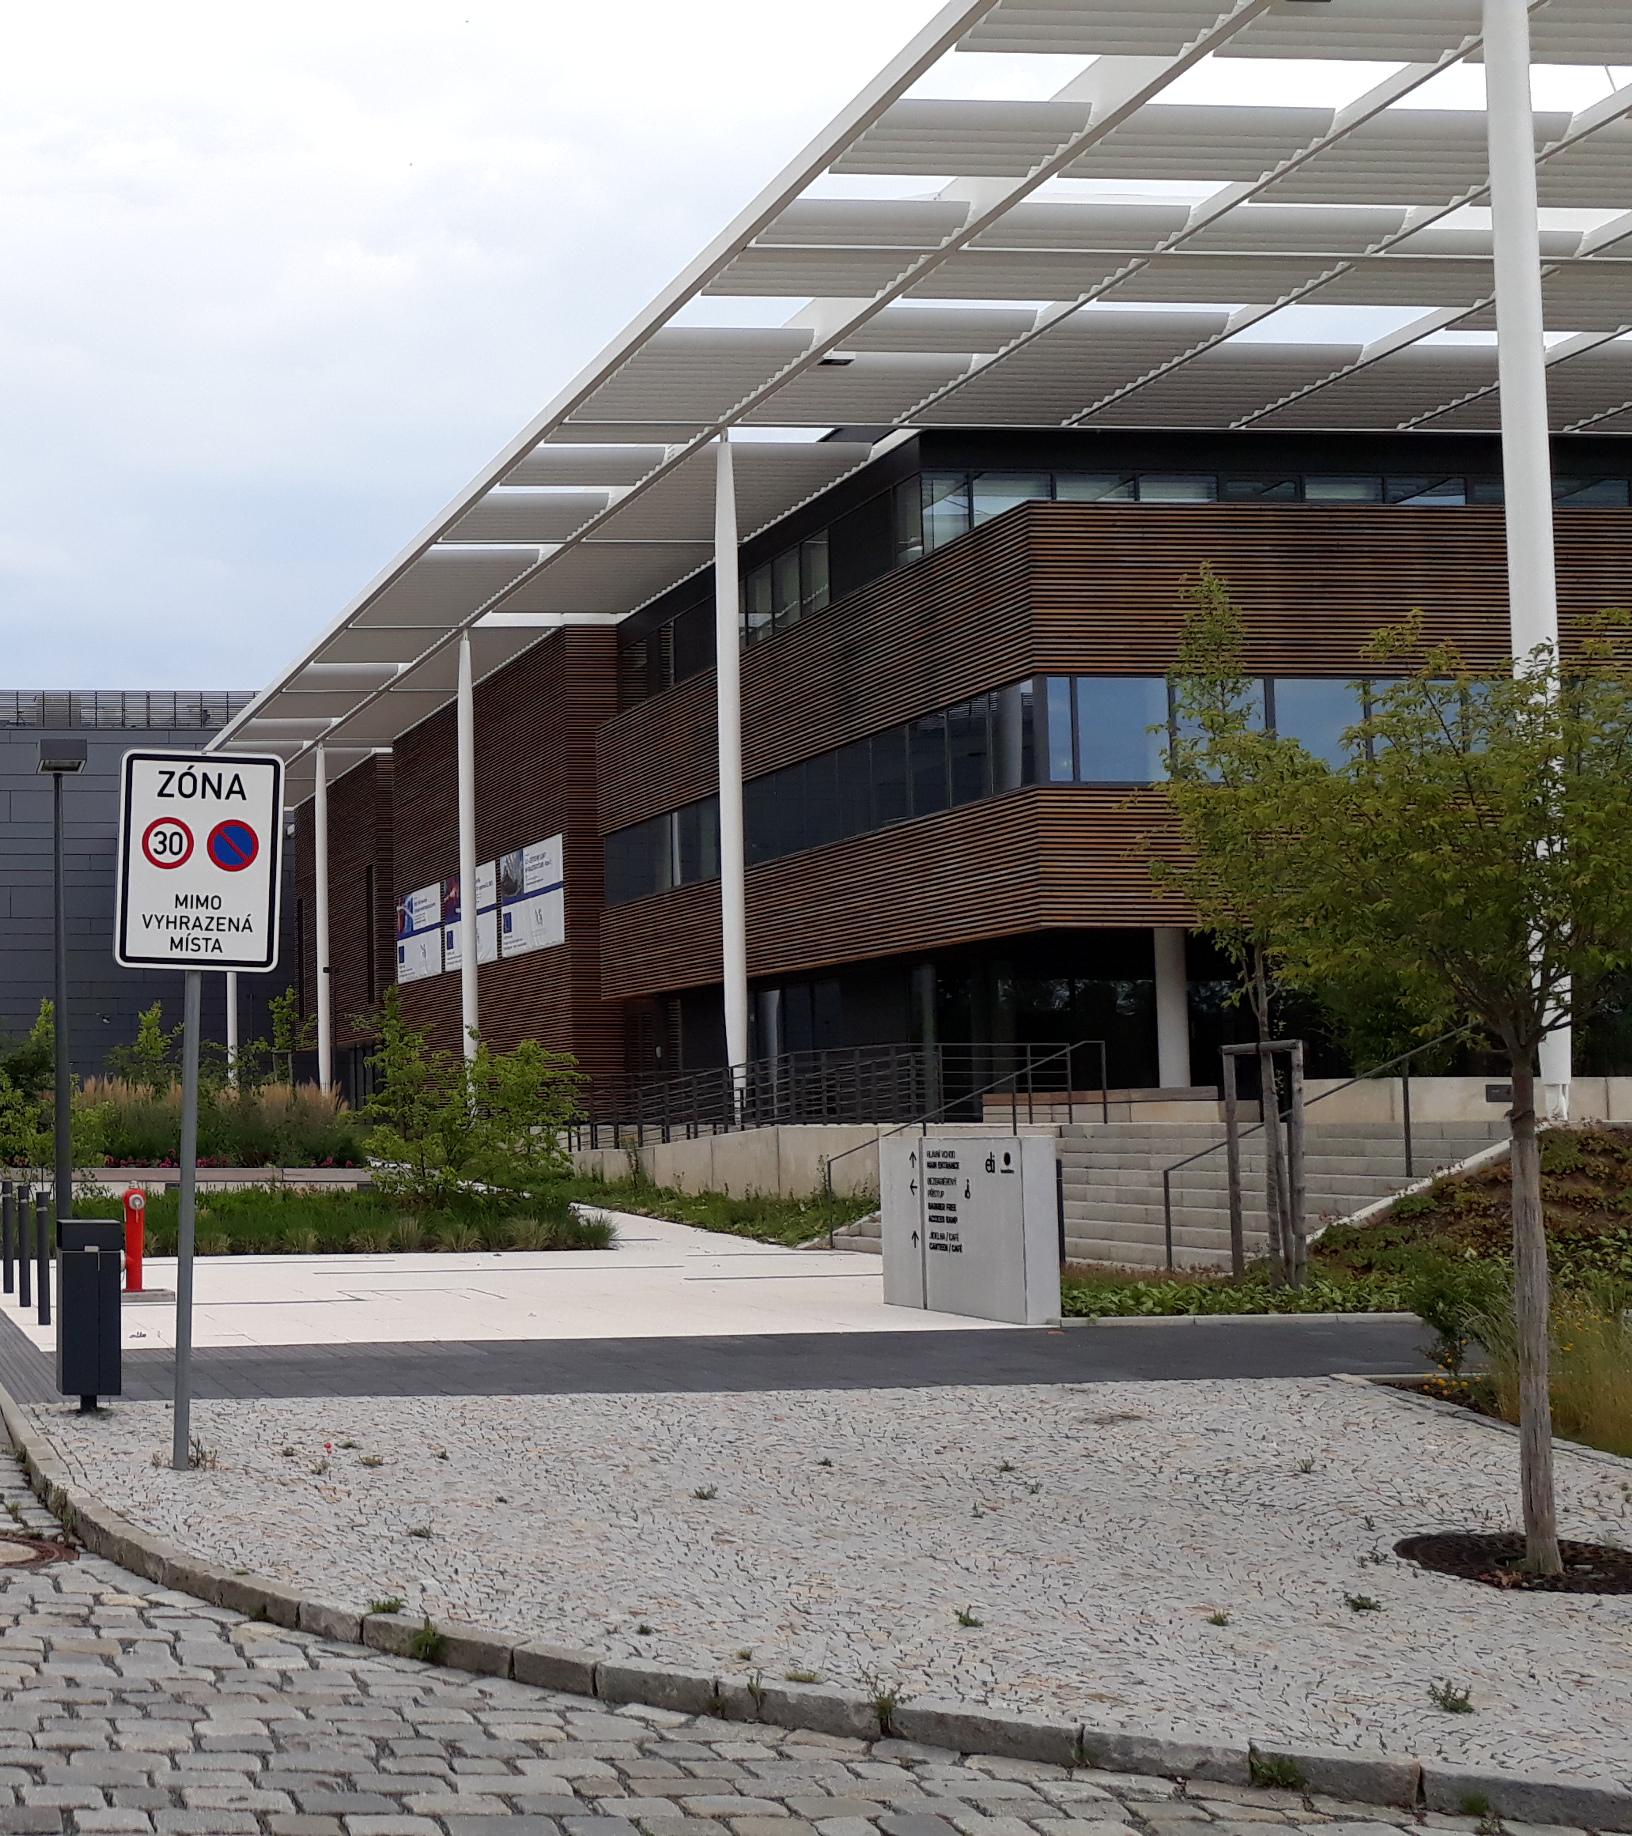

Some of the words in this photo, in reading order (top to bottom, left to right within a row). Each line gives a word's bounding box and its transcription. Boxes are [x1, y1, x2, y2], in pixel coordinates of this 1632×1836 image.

[157, 765, 247, 801] ZÓNA
[153, 831, 183, 856] 30
[174, 894, 222, 911] MIMO
[142, 914, 253, 933] VYHRAZENÁ
[169, 933, 223, 953] MÍSTA
